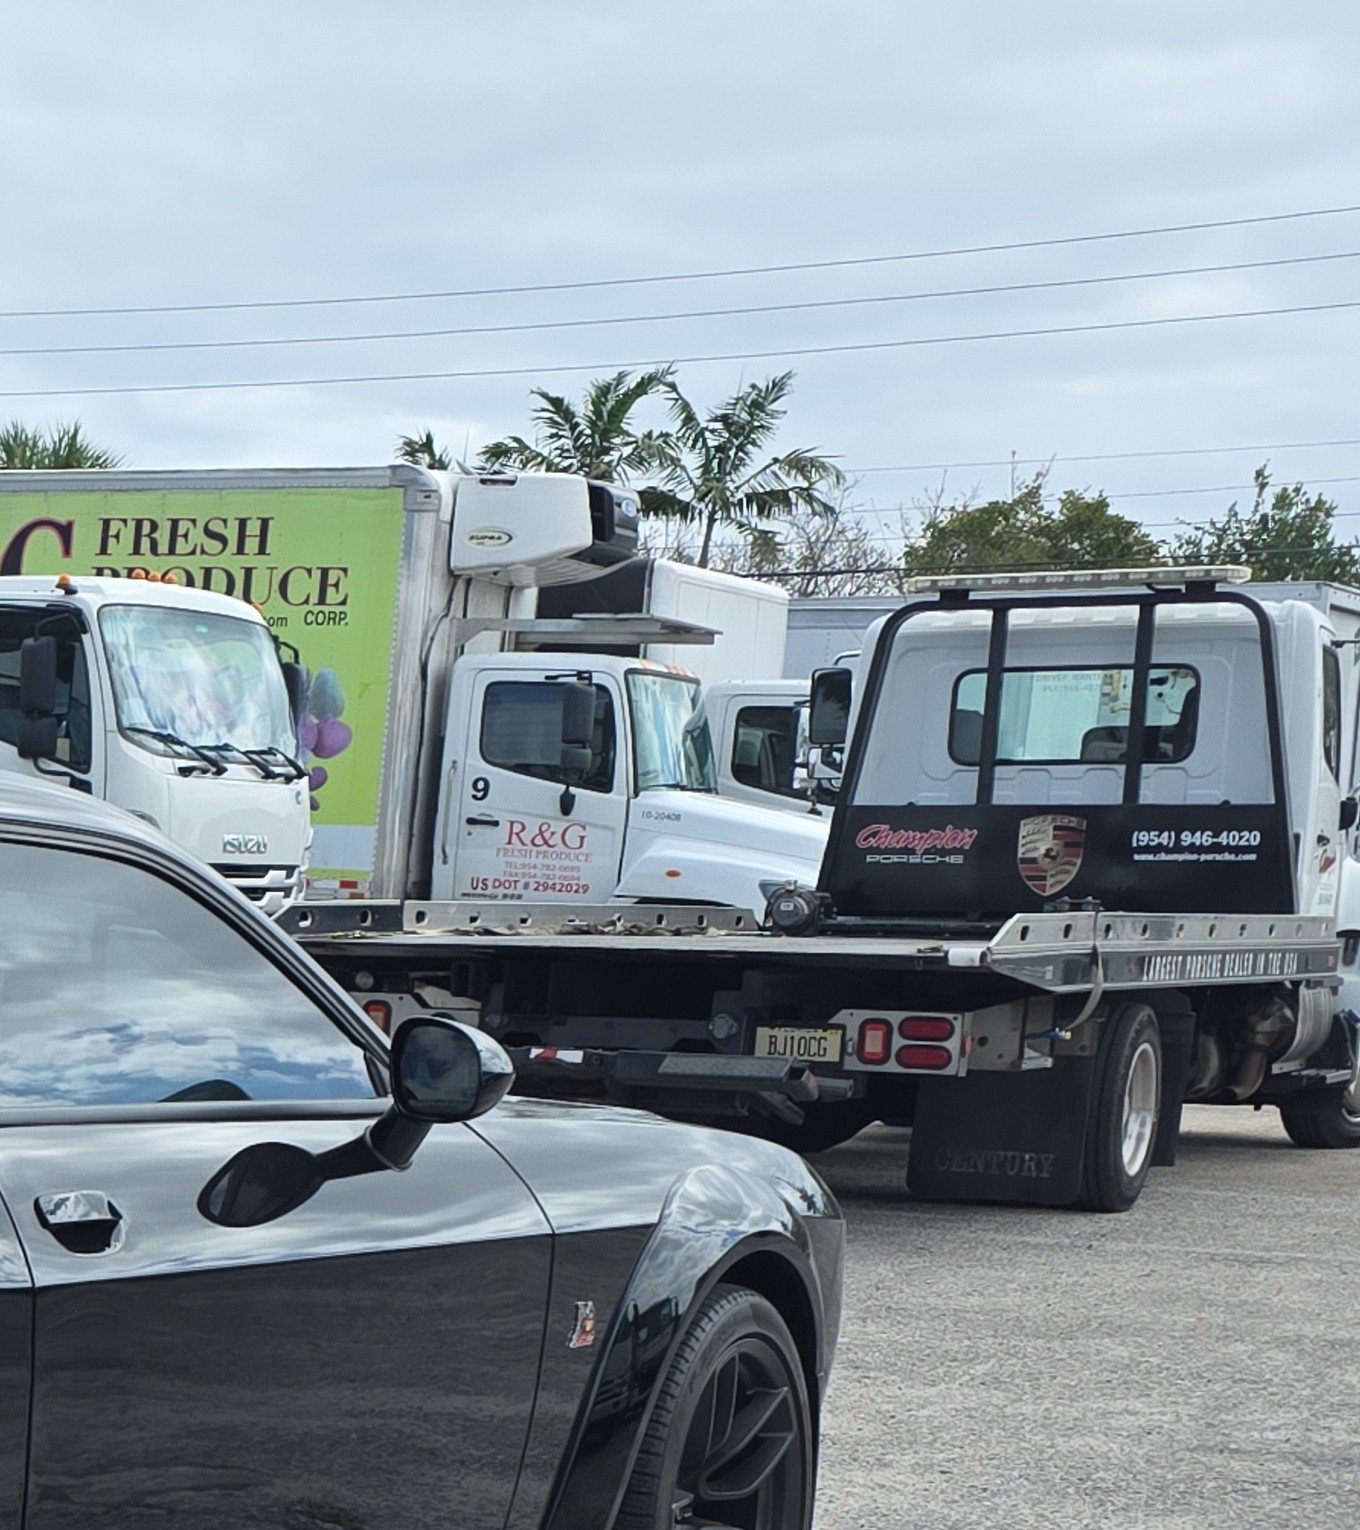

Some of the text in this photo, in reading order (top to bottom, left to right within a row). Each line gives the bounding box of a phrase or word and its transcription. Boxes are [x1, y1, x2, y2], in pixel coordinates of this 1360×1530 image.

[95, 517, 275, 557] FRESH
[303, 610, 349, 626] CORP.
[471, 776, 490, 801] 9
[505, 820, 587, 850] R&G
[856, 824, 978, 855] Champion
[1132, 831, 1260, 848] (954) 946-4020
[495, 847, 593, 863] FRESH PRODUCE
[866, 855, 964, 864] PORSCHE
[470, 877, 488, 891] US
[492, 879, 520, 891] DOT
[533, 881, 590, 894] 2942029
[934, 1146, 1056, 1177] CENTURY
